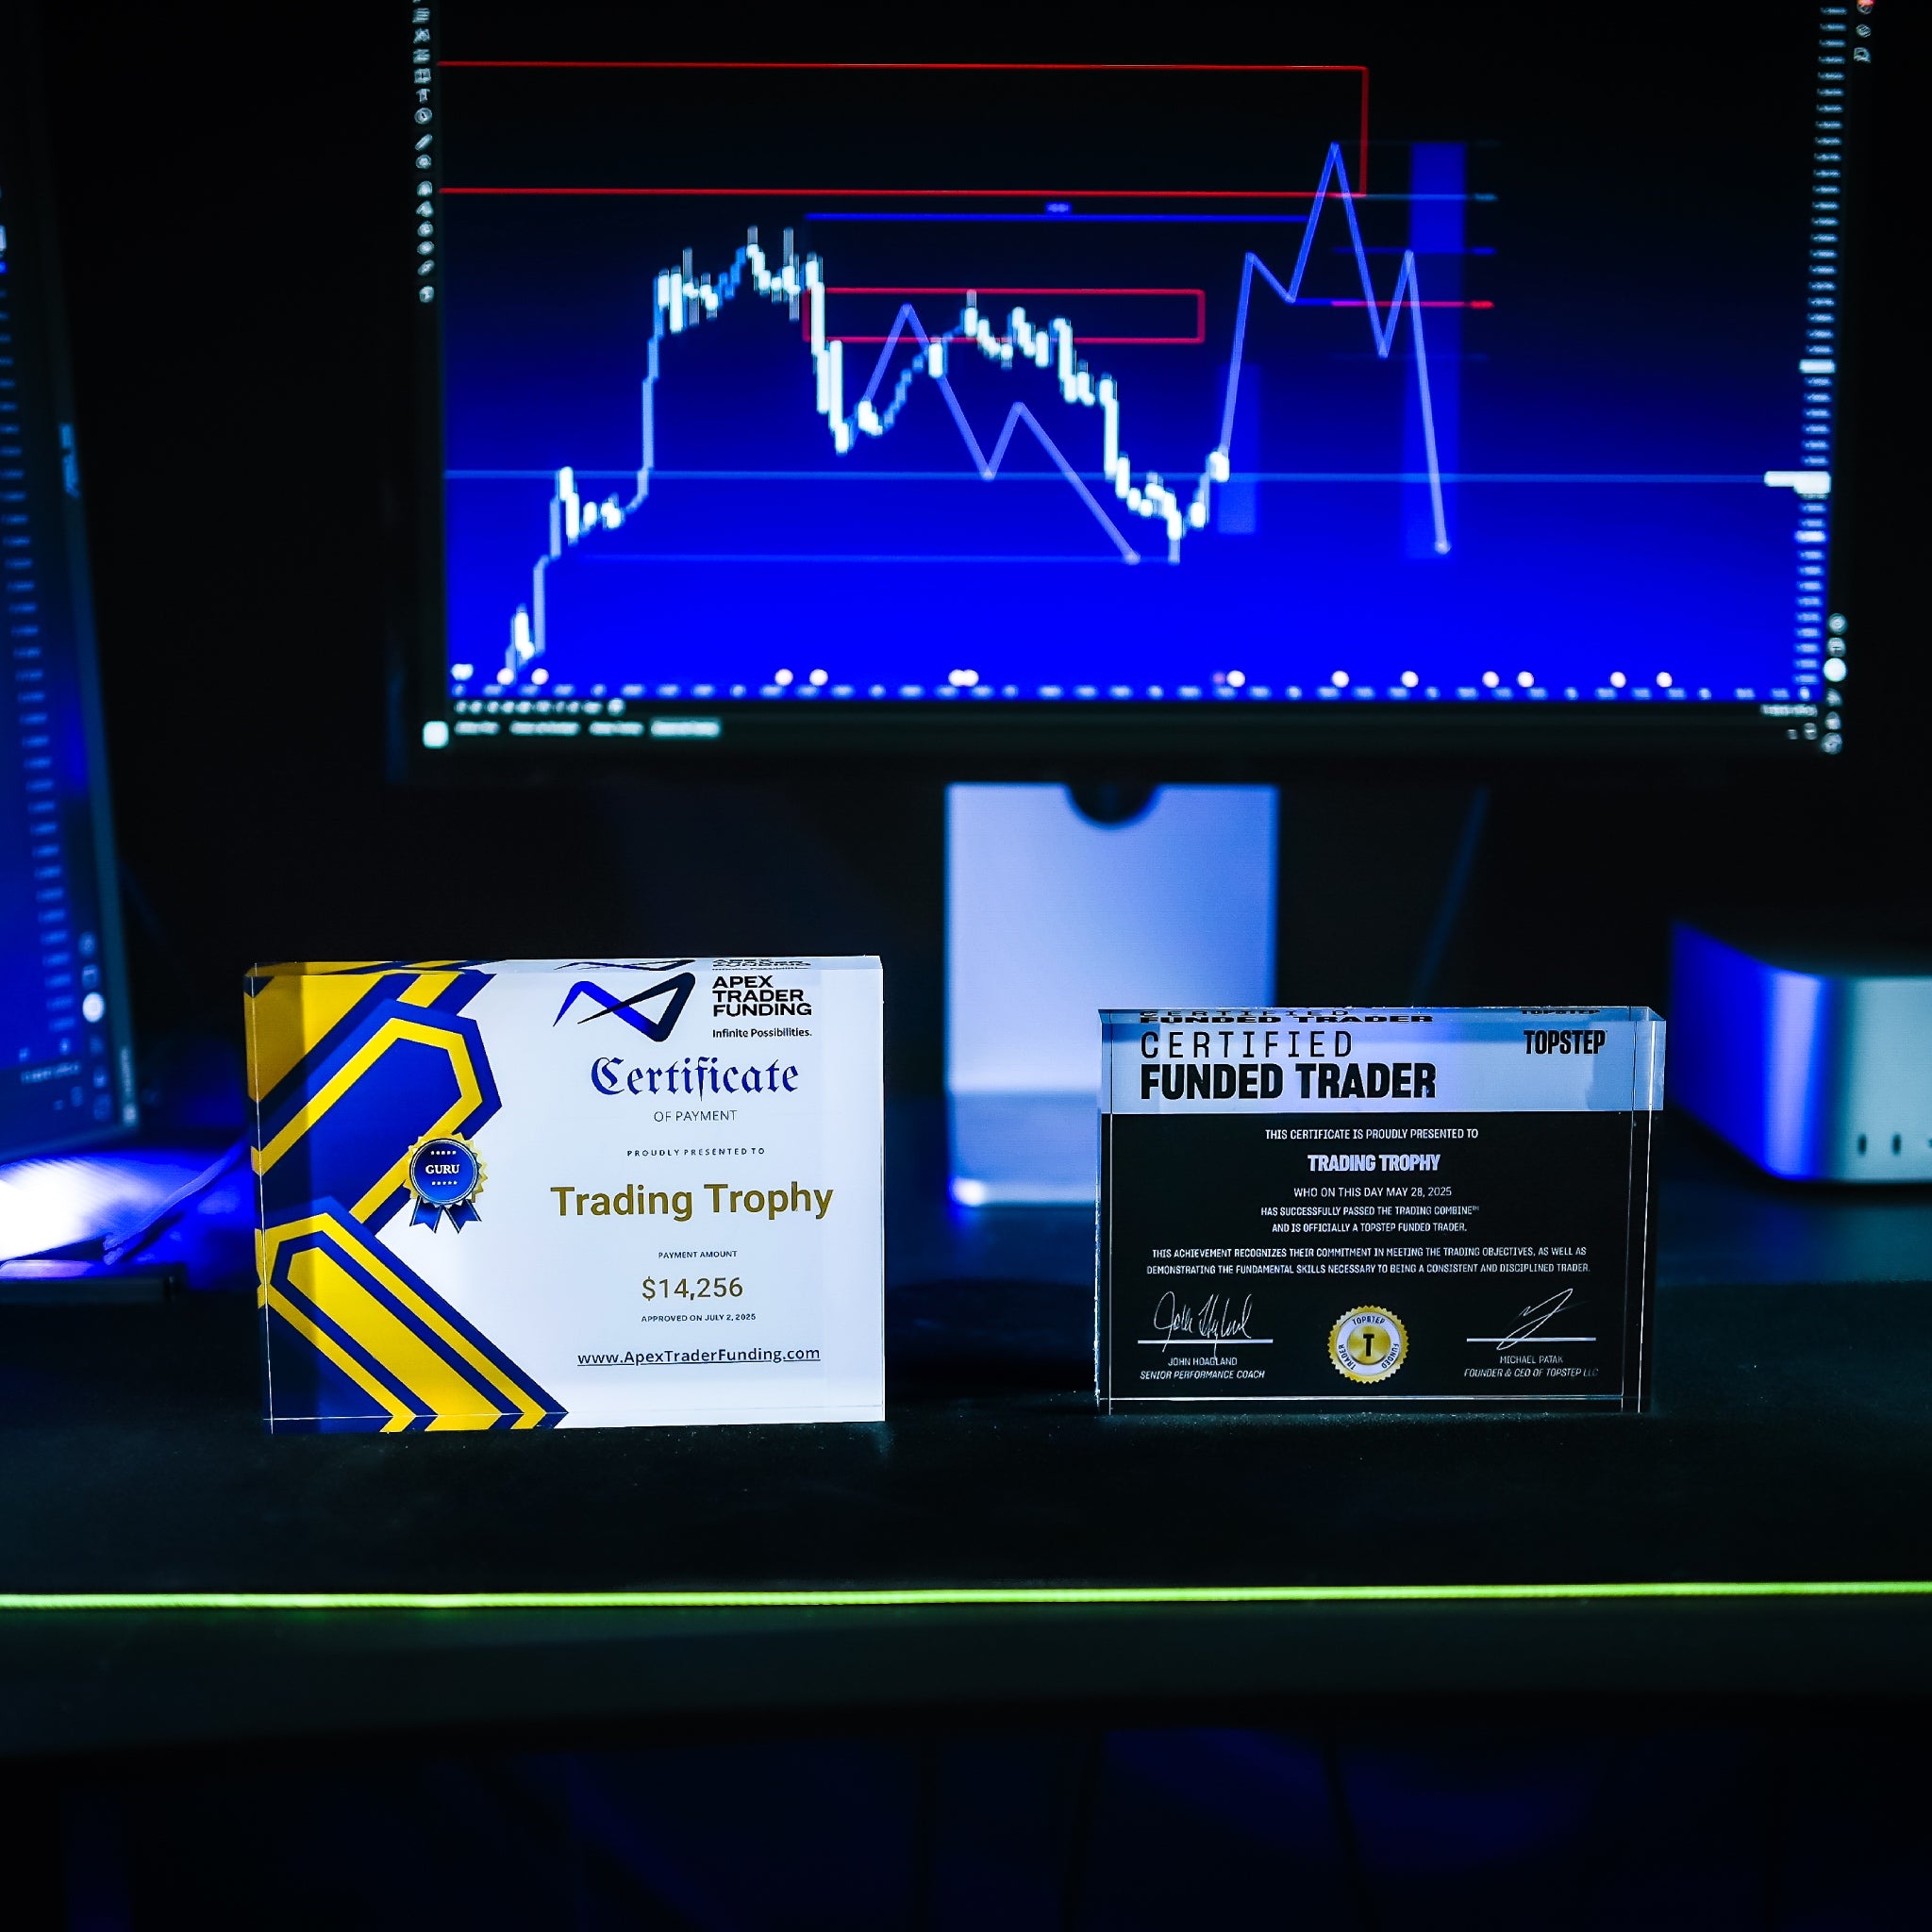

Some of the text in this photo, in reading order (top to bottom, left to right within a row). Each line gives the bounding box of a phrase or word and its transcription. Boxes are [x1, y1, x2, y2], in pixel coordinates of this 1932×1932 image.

[712, 975, 774, 989] APEX
[712, 990, 804, 1002] TRADER
[713, 1003, 812, 1017] FUNDING
[713, 1027, 812, 1038] Infinite Possibilities.
[1141, 1030, 1352, 1058] CERTIFIED
[1524, 1029, 1606, 1055] TOPSTEP
[591, 1057, 799, 1102] Certificate
[1141, 1062, 1436, 1100] FUNDED TRADER
[654, 1109, 738, 1123] OF PAYMENT
[1265, 1128, 1479, 1140] THIS CERTIFICATE IS PROUDLY PRESENTED TO
[425, 1164, 460, 1174] GURU
[1307, 1154, 1441, 1172] TRADING TROPHY
[1294, 1186, 1452, 1198] WHO ON THIS DAY MAY 28, 2025
[551, 1181, 834, 1223] Trading Trophy
[1260, 1207, 1278, 1216] HAS
[1280, 1207, 1341, 1216] SUCCESSFULLY
[1343, 1207, 1375, 1216] PASSED
[1377, 1207, 1392, 1215] THE
[1395, 1206, 1432, 1215] TRADING
[1272, 1223, 1467, 1233] AND IS OFFICIALLY A TOPSTEP FUNDED TRADER.
[1153, 1247, 1587, 1258] THIS ACHIEVEMENT RECOGNIZES THEIR COMMITMENT IN MEETING THE TRADING OBJECTIVES, AS WELL AS
[1146, 1263, 1591, 1274] DEMONSTRATING THE FUNDAMENTAL SKILLS NECESSARY TO BEING A CONSISTENT AND DISCIPLINED TRADER.
[642, 1276, 743, 1302] $14,256
[1352, 1315, 1386, 1325] TOPSTEP
[1363, 1333, 1374, 1357] T
[577, 1347, 821, 1366] www.ApexTraderFunding.com
[1168, 1357, 1238, 1366] JOHN HOAGLAND
[1338, 1343, 1357, 1370] TRADER
[1381, 1343, 1400, 1369] FUNDED
[1500, 1356, 1537, 1364] MICHAEL
[1140, 1370, 1266, 1379] SENIOR PERFORMANCE COACH
[1464, 1369, 1504, 1377] FOUNDER
[1504, 1368, 1512, 1377] &
[1514, 1368, 1530, 1377] CEO
[1532, 1368, 1544, 1377] OF
[1546, 1368, 1582, 1377] TOPSTEP
